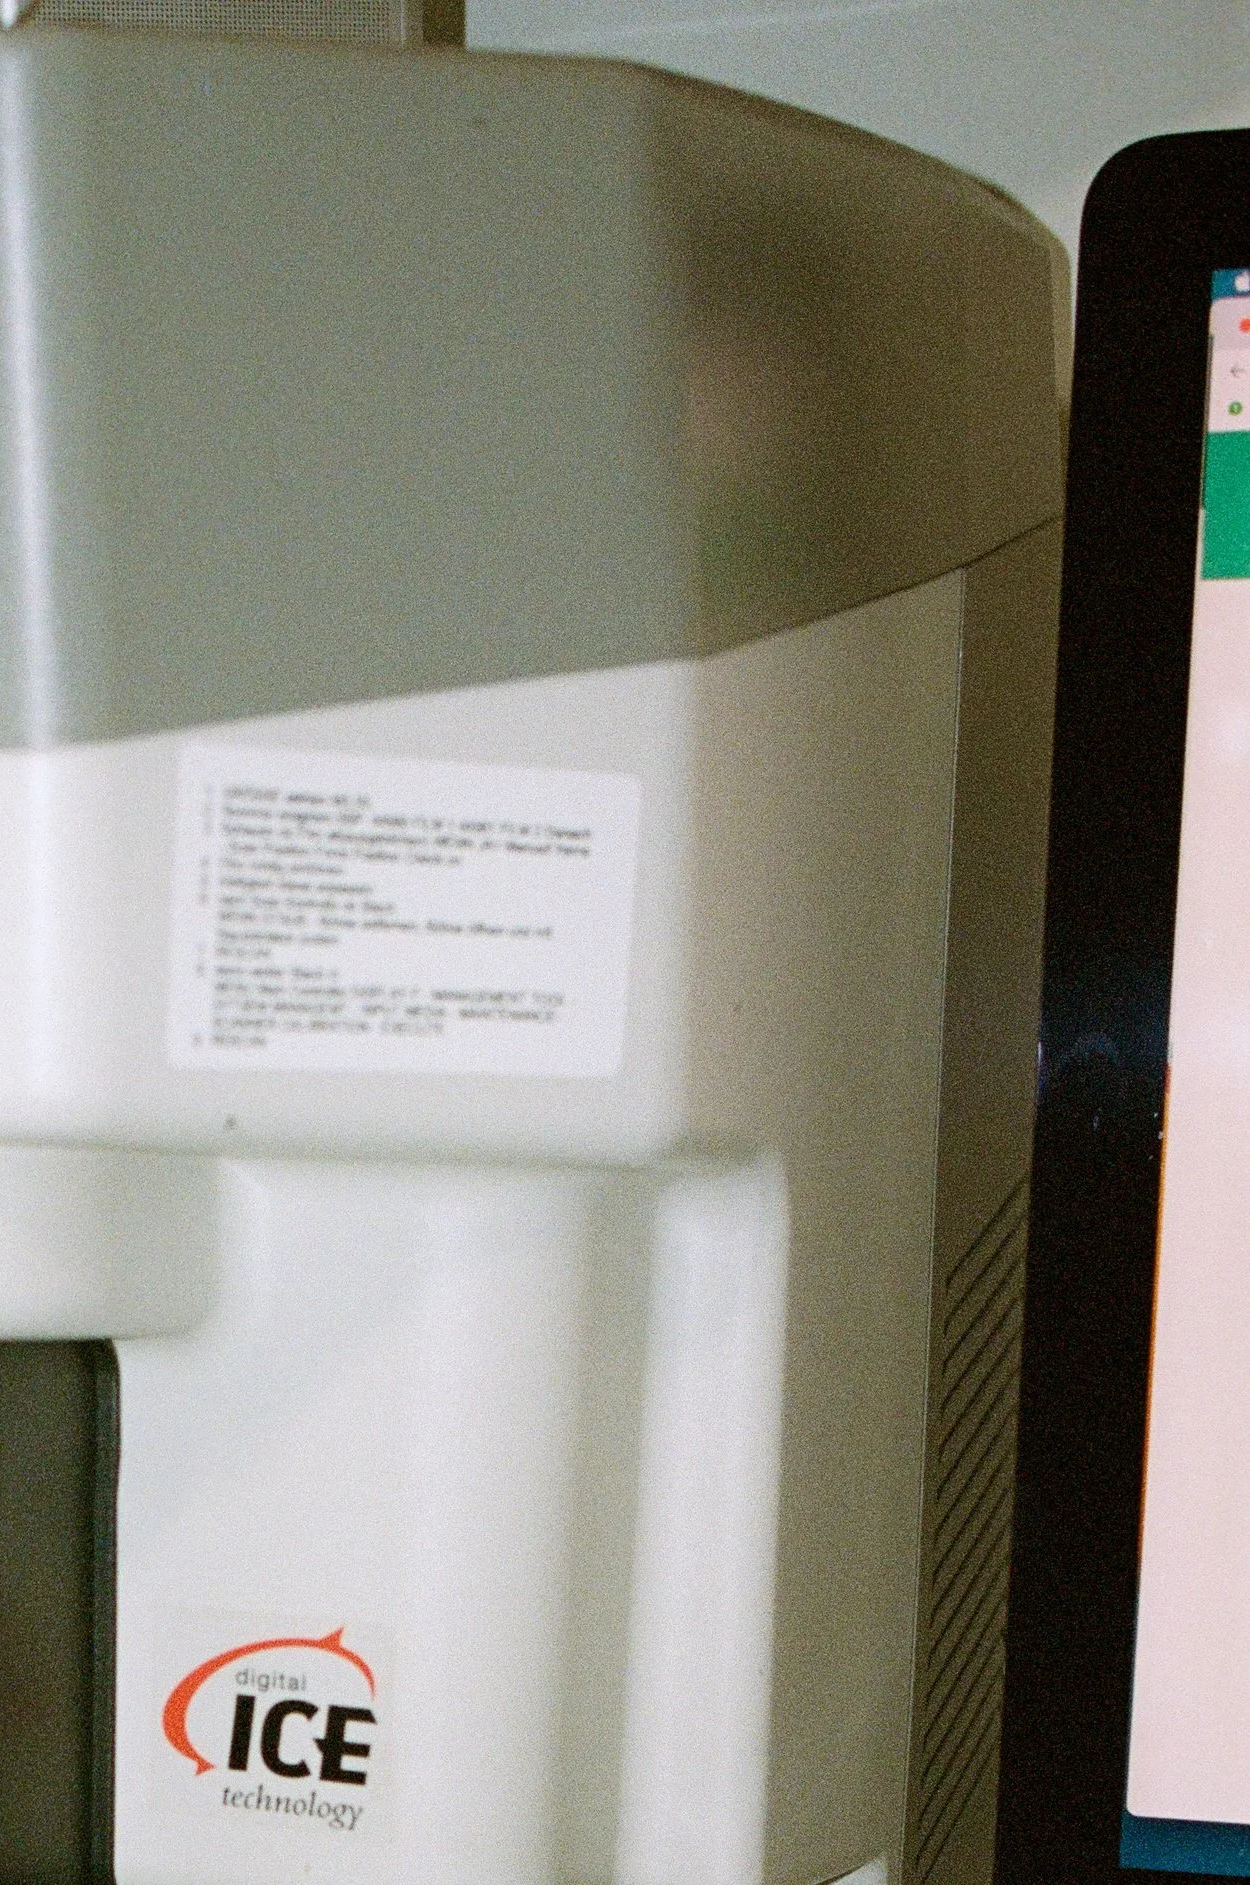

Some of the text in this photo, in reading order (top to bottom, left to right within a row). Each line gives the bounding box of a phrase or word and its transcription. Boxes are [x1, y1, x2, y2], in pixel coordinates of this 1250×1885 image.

[234, 1667, 307, 1693] digital
[227, 1693, 378, 1786] ICE
[221, 1783, 364, 1831] technology
